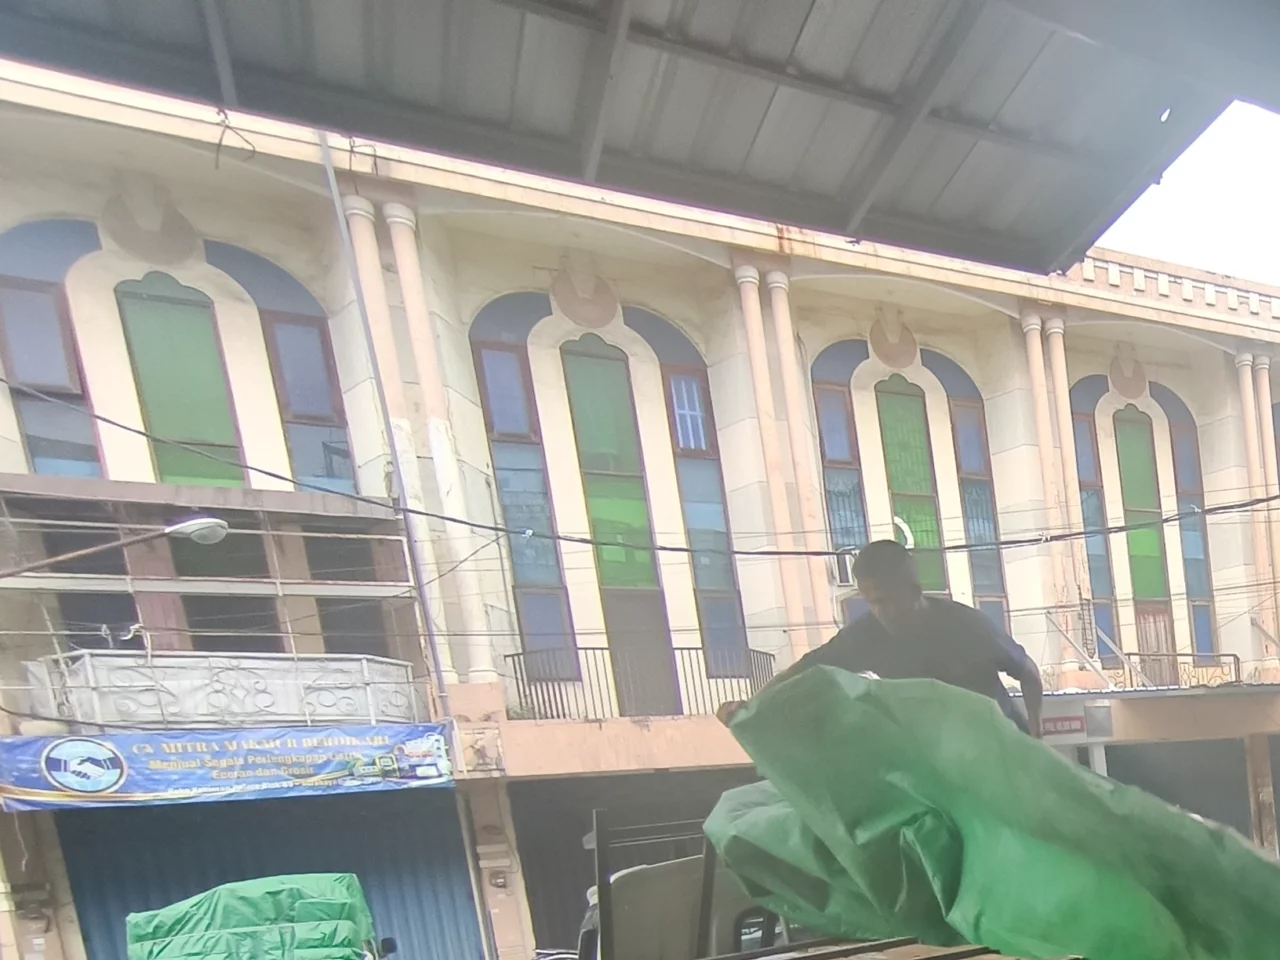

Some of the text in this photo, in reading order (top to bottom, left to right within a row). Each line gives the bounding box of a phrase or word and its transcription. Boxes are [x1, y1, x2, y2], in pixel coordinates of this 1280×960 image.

[160, 742, 220, 753] MITRA
[150, 758, 200, 770] Menjual
[205, 756, 244, 768] Segala
[247, 753, 326, 765] Perlengkapan
[257, 767, 277, 777] dan
[280, 766, 314, 775] Grosir
